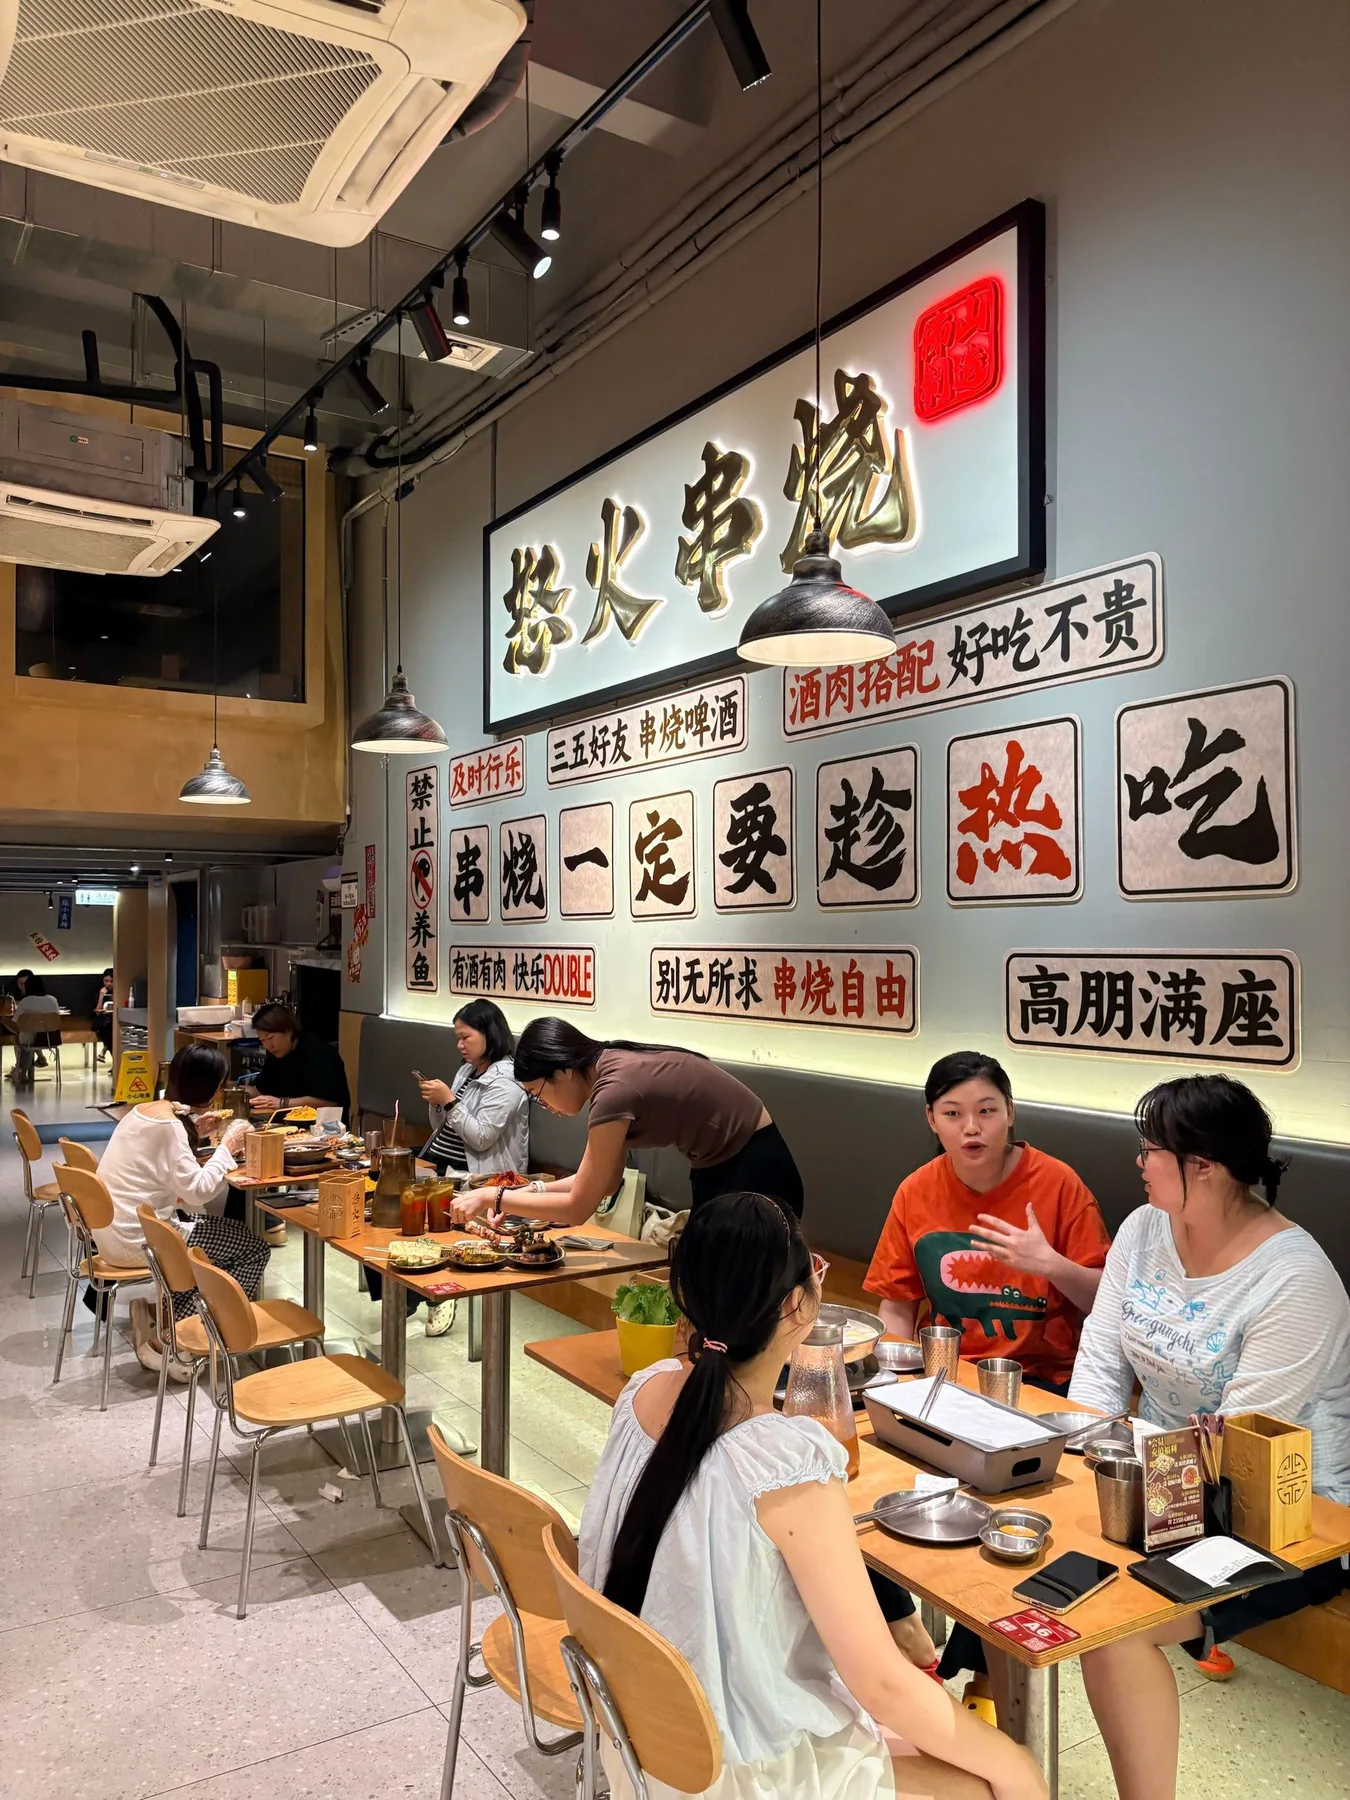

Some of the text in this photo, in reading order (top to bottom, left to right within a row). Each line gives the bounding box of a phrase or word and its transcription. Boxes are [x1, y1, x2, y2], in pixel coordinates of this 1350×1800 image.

[789, 579, 1148, 726] 酒肉搭配 好吃不贵
[451, 746, 522, 799] 及时行乐
[551, 690, 738, 775] 三五好友 串烧啤酒
[822, 767, 912, 891] 趁
[956, 740, 1072, 884] 热
[1124, 717, 1280, 865] 吃
[408, 773, 436, 987] 禁止 养鱼
[453, 834, 485, 916] 串
[502, 830, 546, 910] 烧
[564, 846, 609, 872] 一
[634, 809, 692, 906] 定
[718, 782, 788, 894] 要
[452, 950, 506, 990] 有酒有肉
[656, 955, 908, 1020] 别无所求 串烧自由
[1015, 964, 1284, 1048] 高朋满座
[1022, 1622, 1053, 1637] A6
